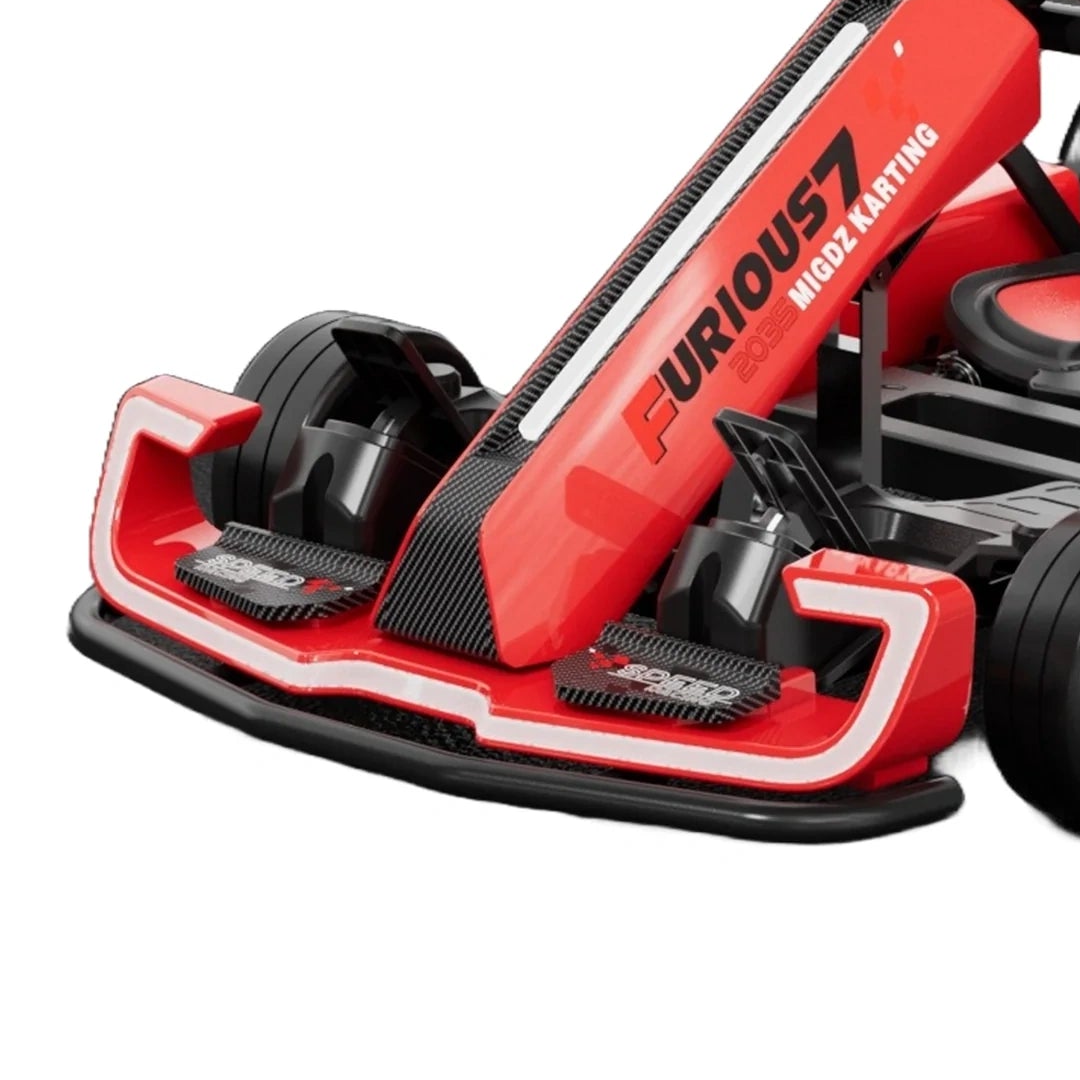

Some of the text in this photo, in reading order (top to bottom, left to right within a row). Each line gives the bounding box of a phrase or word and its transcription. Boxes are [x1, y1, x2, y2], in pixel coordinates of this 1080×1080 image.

[620, 125, 861, 465] FURIOUS7
[728, 122, 939, 383] 2035 MIGDZ KARTING
